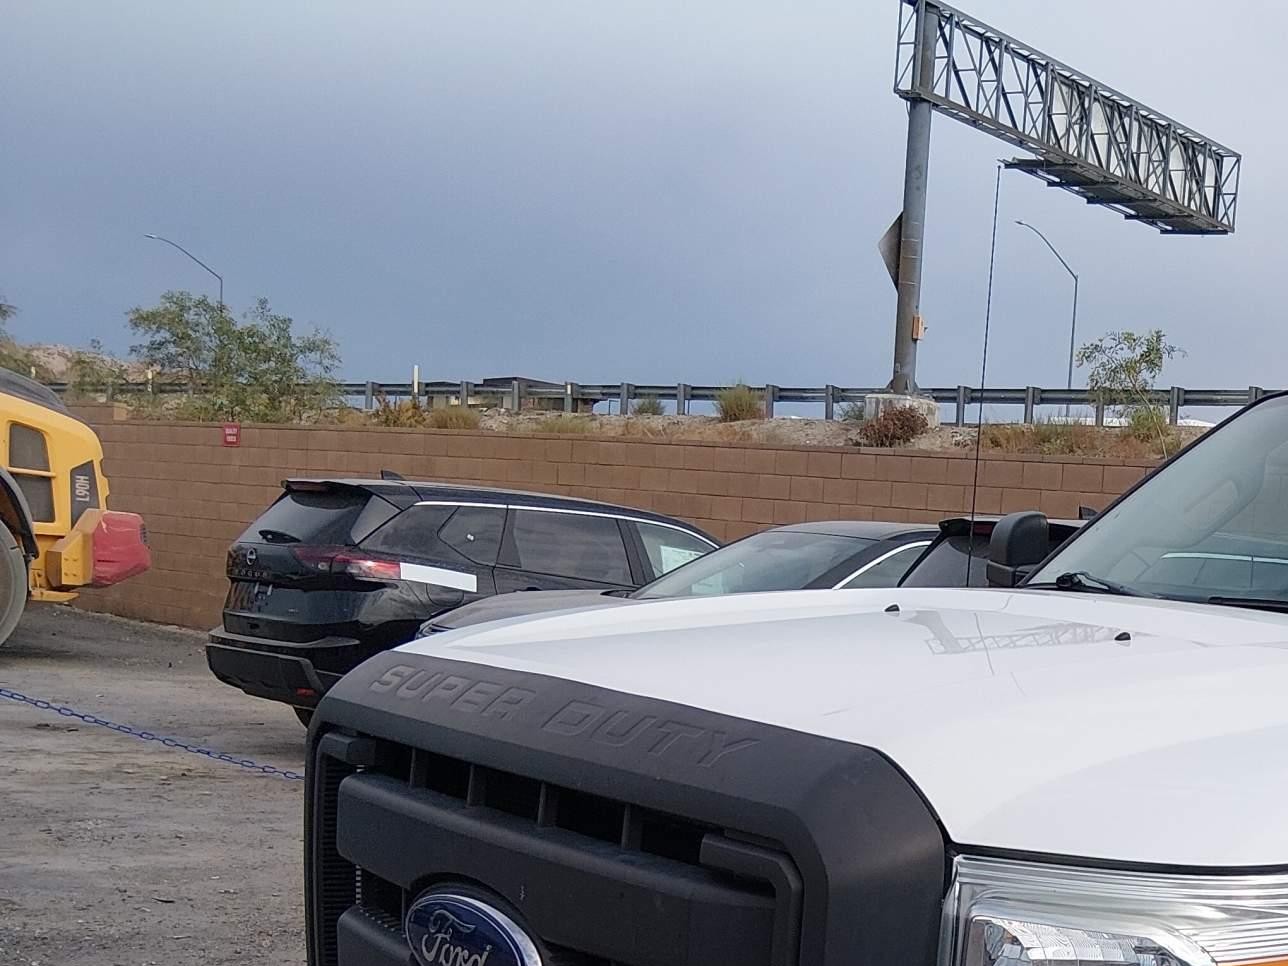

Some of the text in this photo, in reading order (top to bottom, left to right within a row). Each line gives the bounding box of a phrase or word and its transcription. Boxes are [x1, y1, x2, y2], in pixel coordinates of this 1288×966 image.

[74, 475, 90, 503] L90H
[368, 663, 760, 768] SUPER DUTY
